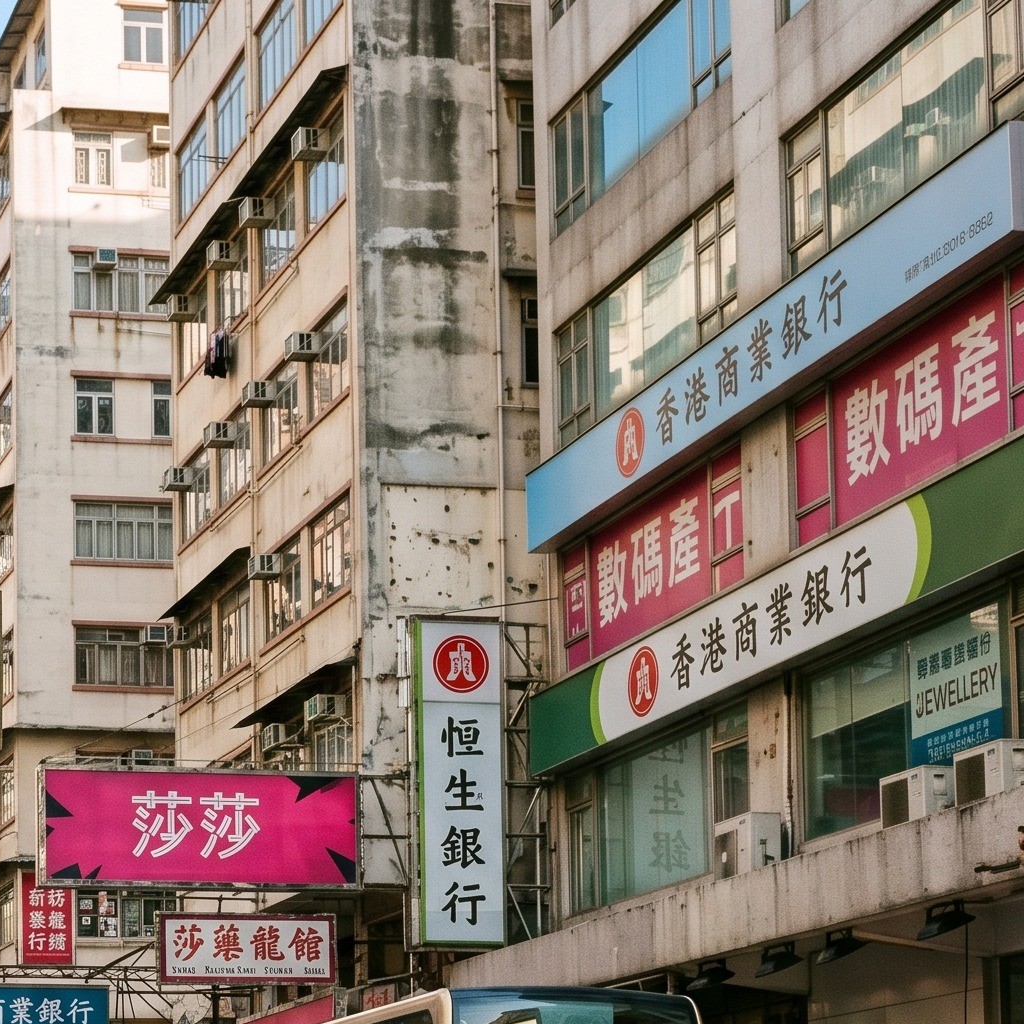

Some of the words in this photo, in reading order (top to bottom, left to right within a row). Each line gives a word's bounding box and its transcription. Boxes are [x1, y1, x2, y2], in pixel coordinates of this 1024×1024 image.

[655, 269, 848, 446] 香港商業銀行
[845, 310, 1001, 487] 數碼產
[597, 496, 701, 629] 數碼產
[671, 546, 872, 690] 香港商業銀行
[131, 790, 261, 861] 莎莎
[440, 716, 486, 926] 恒生銀行
